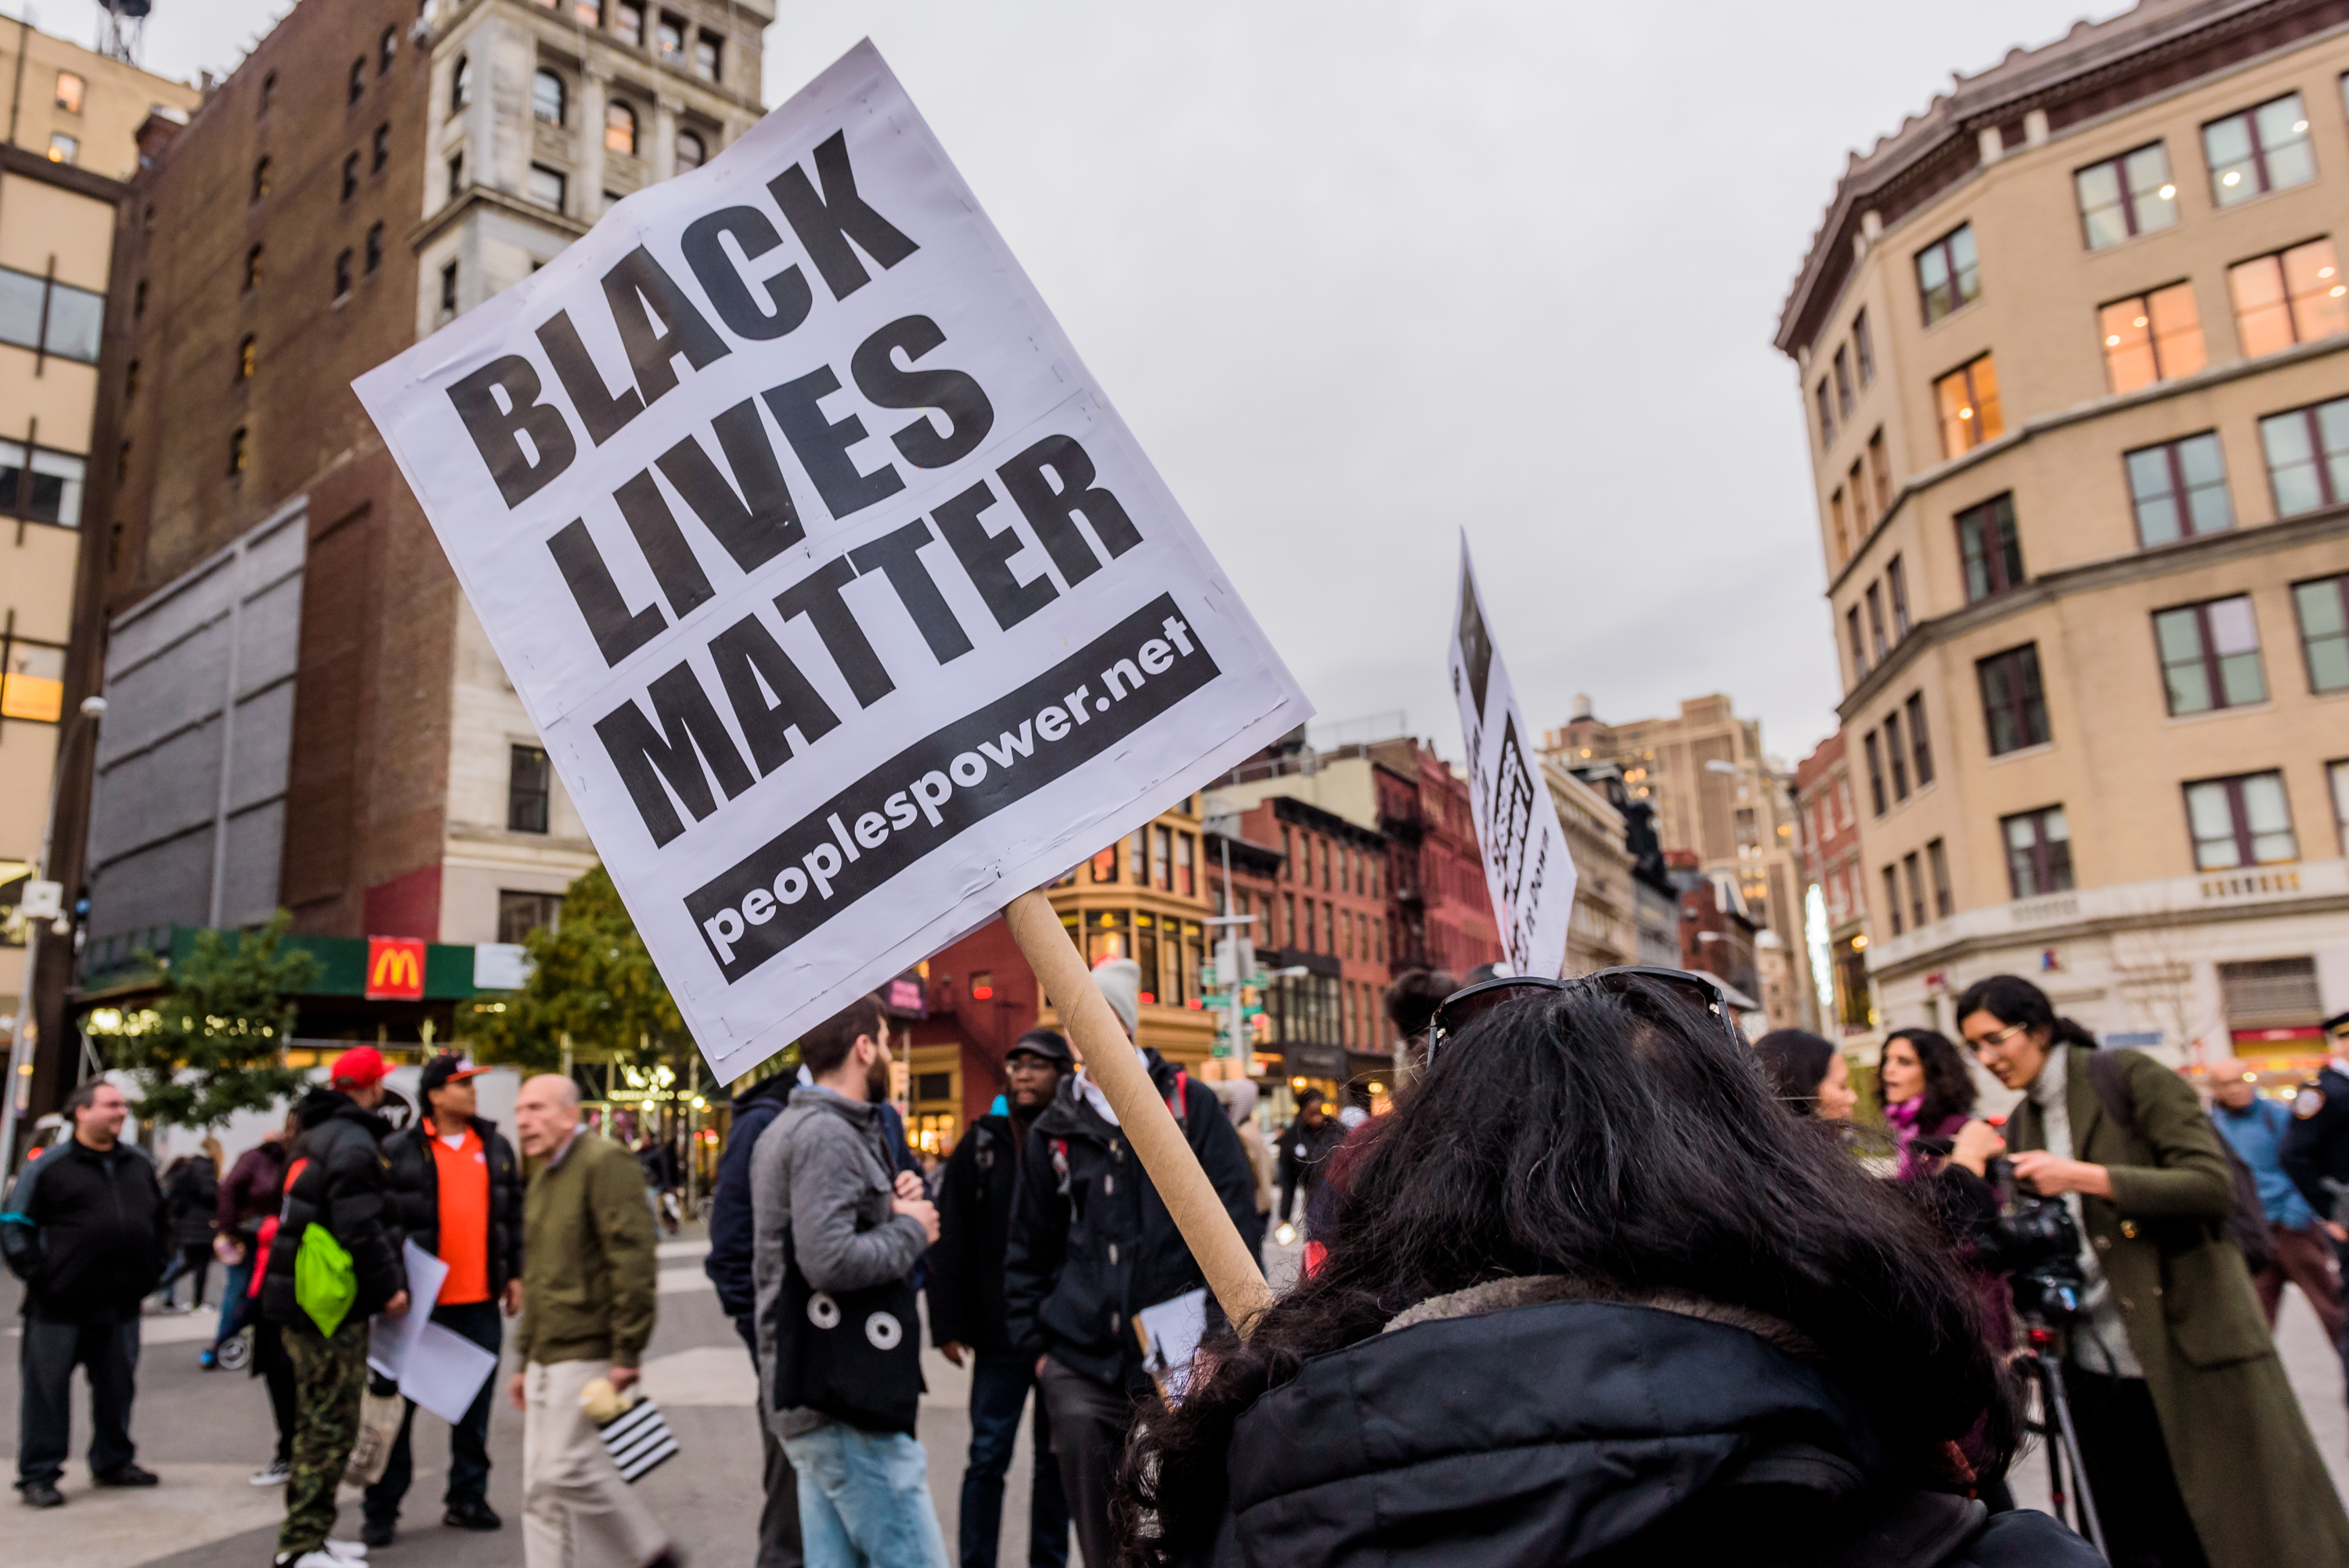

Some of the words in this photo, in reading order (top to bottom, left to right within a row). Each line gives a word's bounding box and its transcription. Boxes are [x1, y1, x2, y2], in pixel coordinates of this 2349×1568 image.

[445, 128, 921, 510] BLACK
[545, 314, 994, 669] LIVES
[592, 434, 1144, 850] MATTER
[703, 615, 1195, 965] peoplespower.net
